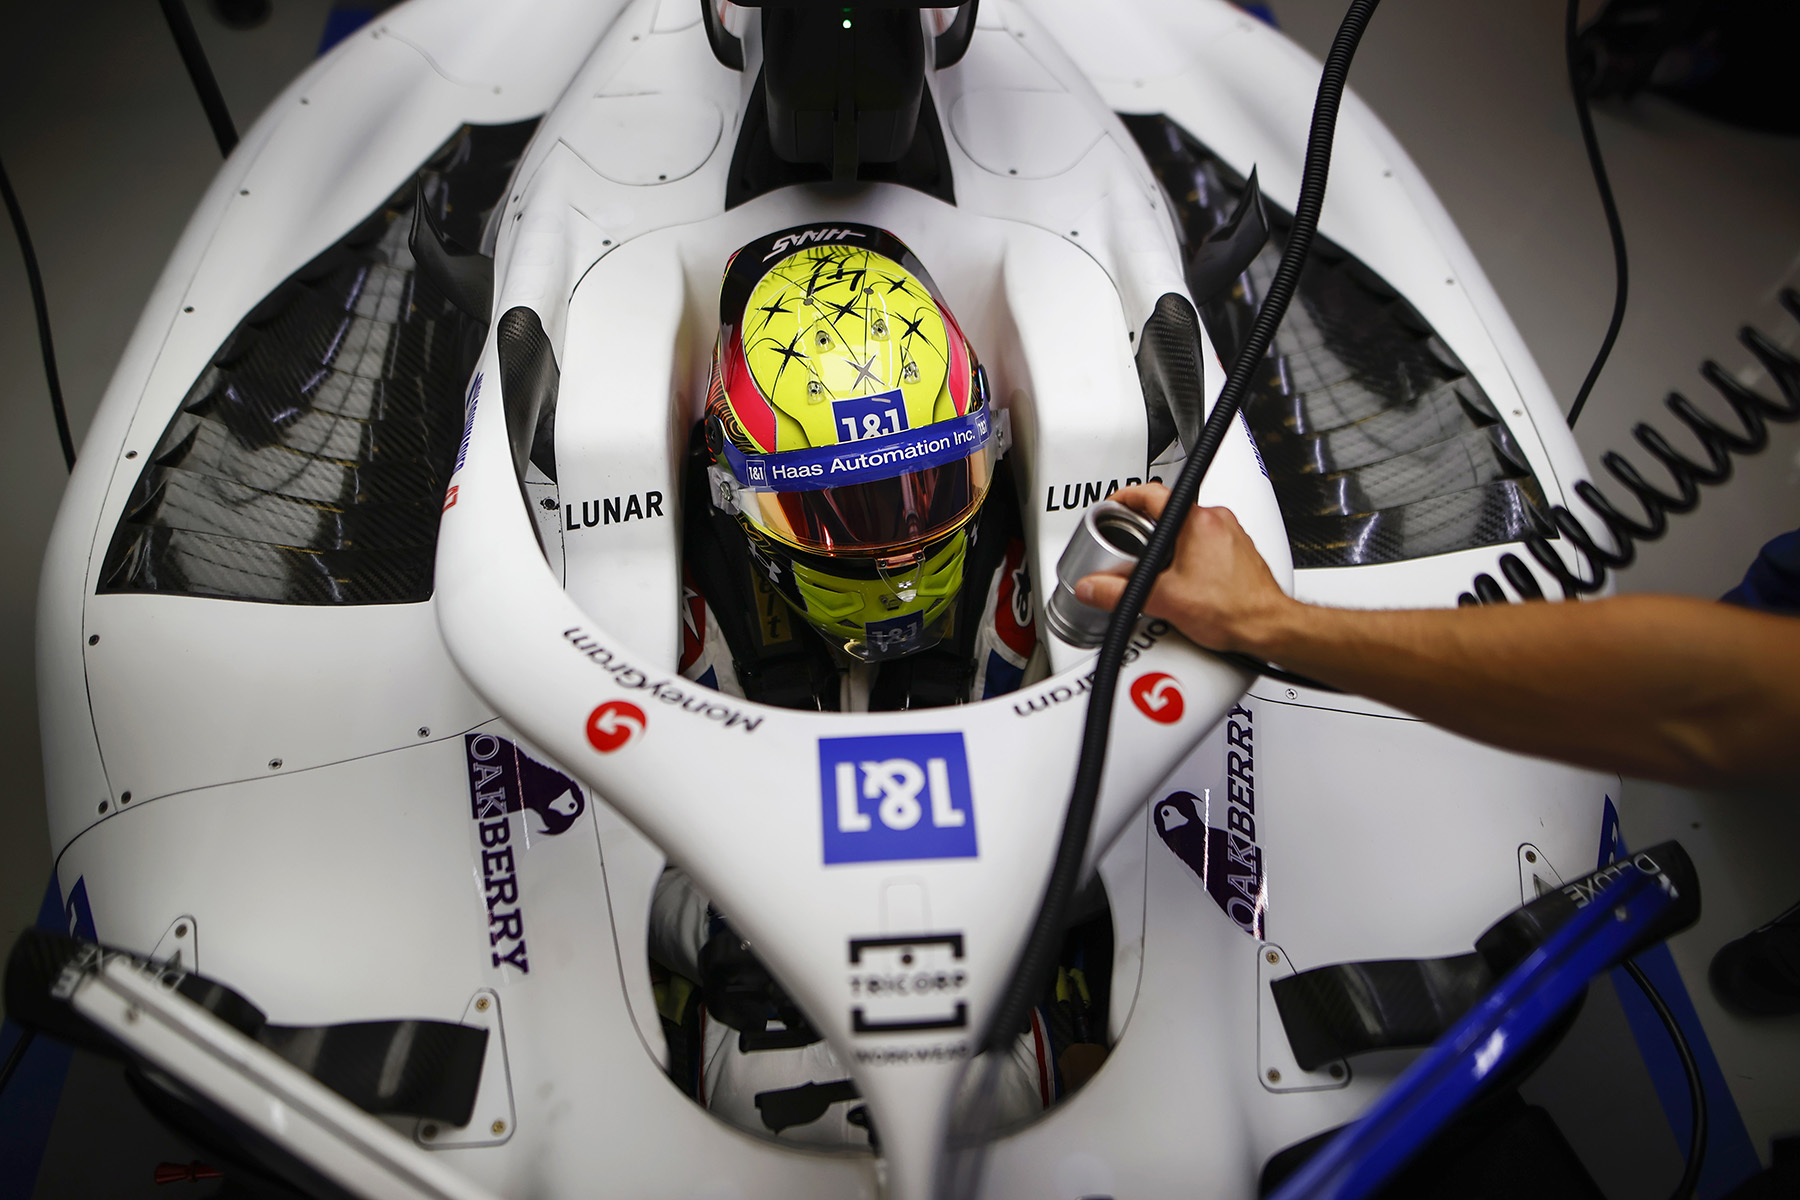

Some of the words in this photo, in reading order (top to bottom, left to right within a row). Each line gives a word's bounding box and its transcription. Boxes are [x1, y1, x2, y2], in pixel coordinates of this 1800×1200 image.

[772, 463, 824, 480] Haas
[830, 436, 951, 474] Automation
[953, 428, 976, 446] Inc.
[841, 408, 901, 441] 1&1
[566, 490, 664, 531] LUNAR
[748, 466, 765, 481] 1&1
[563, 627, 764, 732] MoneyGram
[1013, 617, 1170, 717] oneram
[834, 757, 966, 833] 1&1
[1226, 702, 1258, 932] OAKBERRY
[470, 733, 530, 975] OAKBERRY
